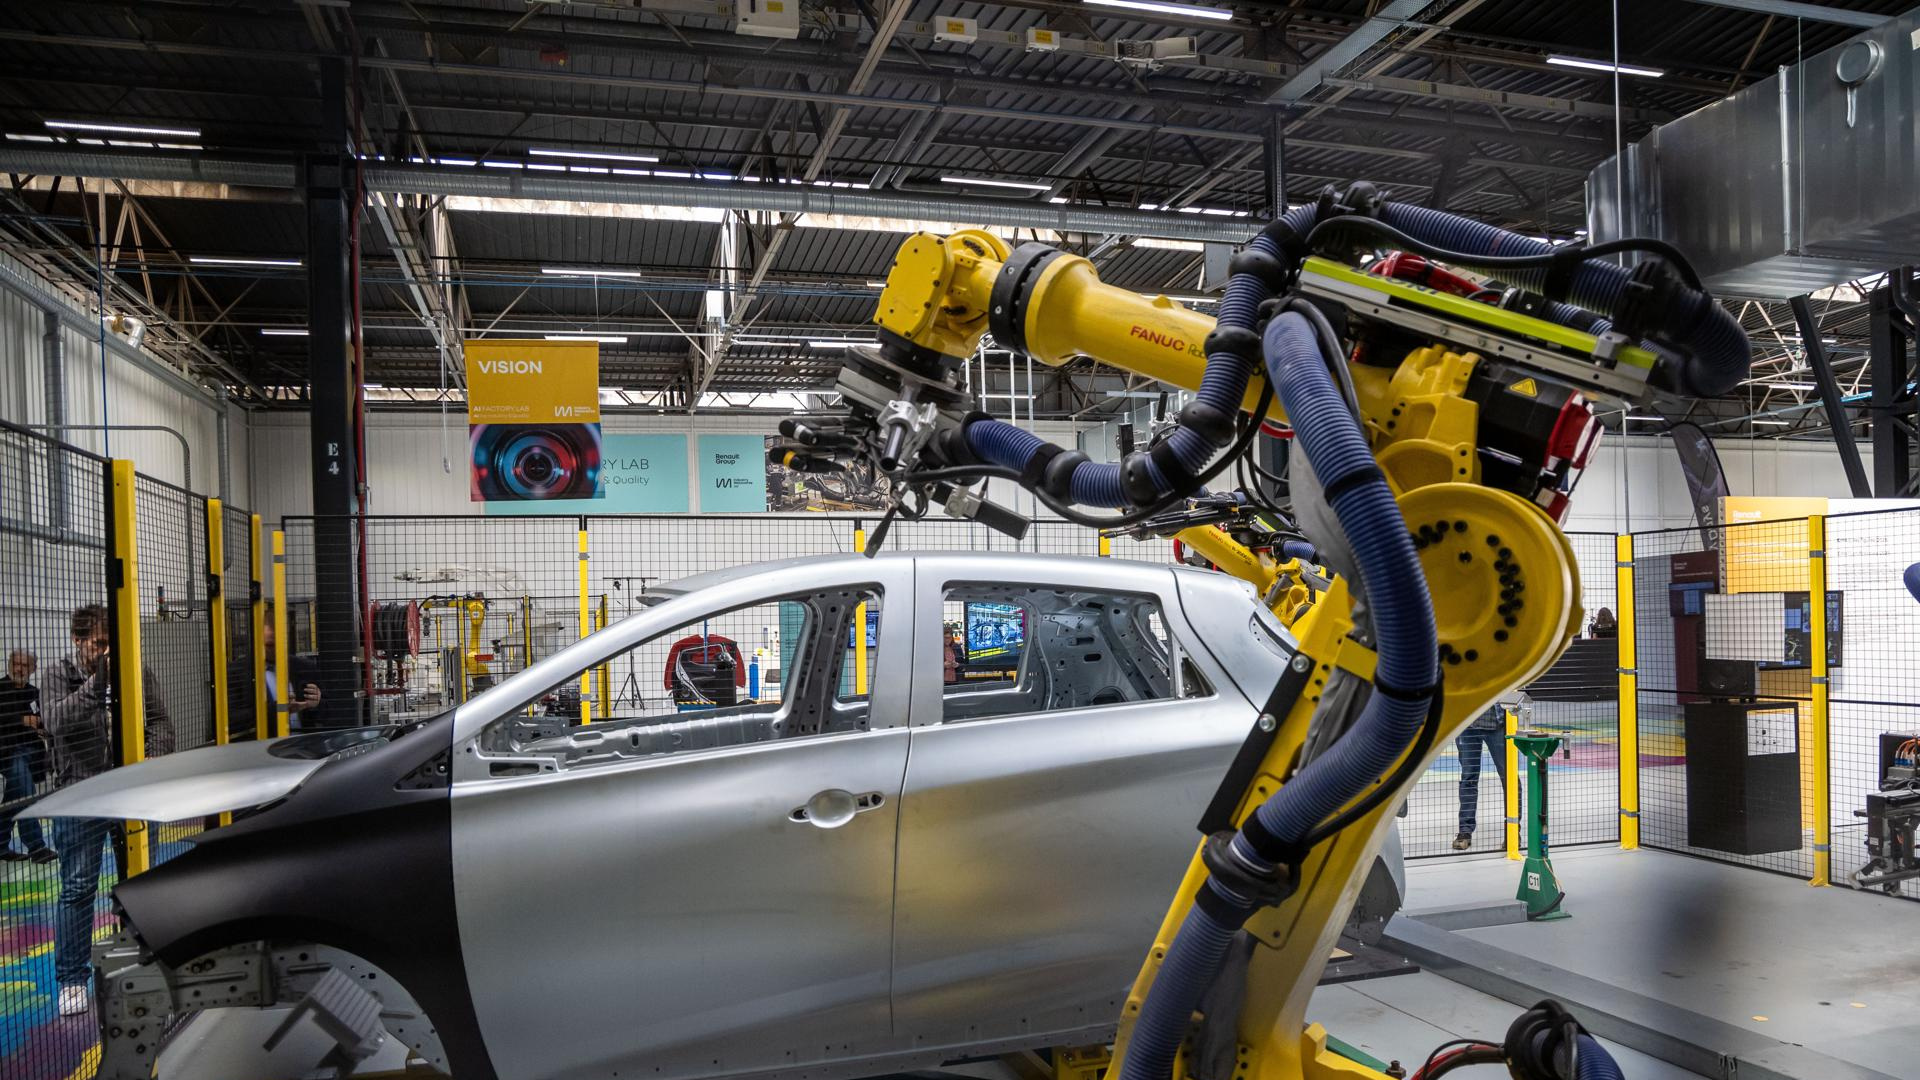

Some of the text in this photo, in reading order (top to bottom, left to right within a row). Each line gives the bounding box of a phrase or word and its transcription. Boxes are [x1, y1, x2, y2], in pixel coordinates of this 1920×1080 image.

[1130, 325, 1185, 351] FANUC
[478, 360, 543, 374] VISION
[328, 461, 340, 475] 4
[621, 458, 649, 470] LAB
[612, 475, 650, 486] Quality
